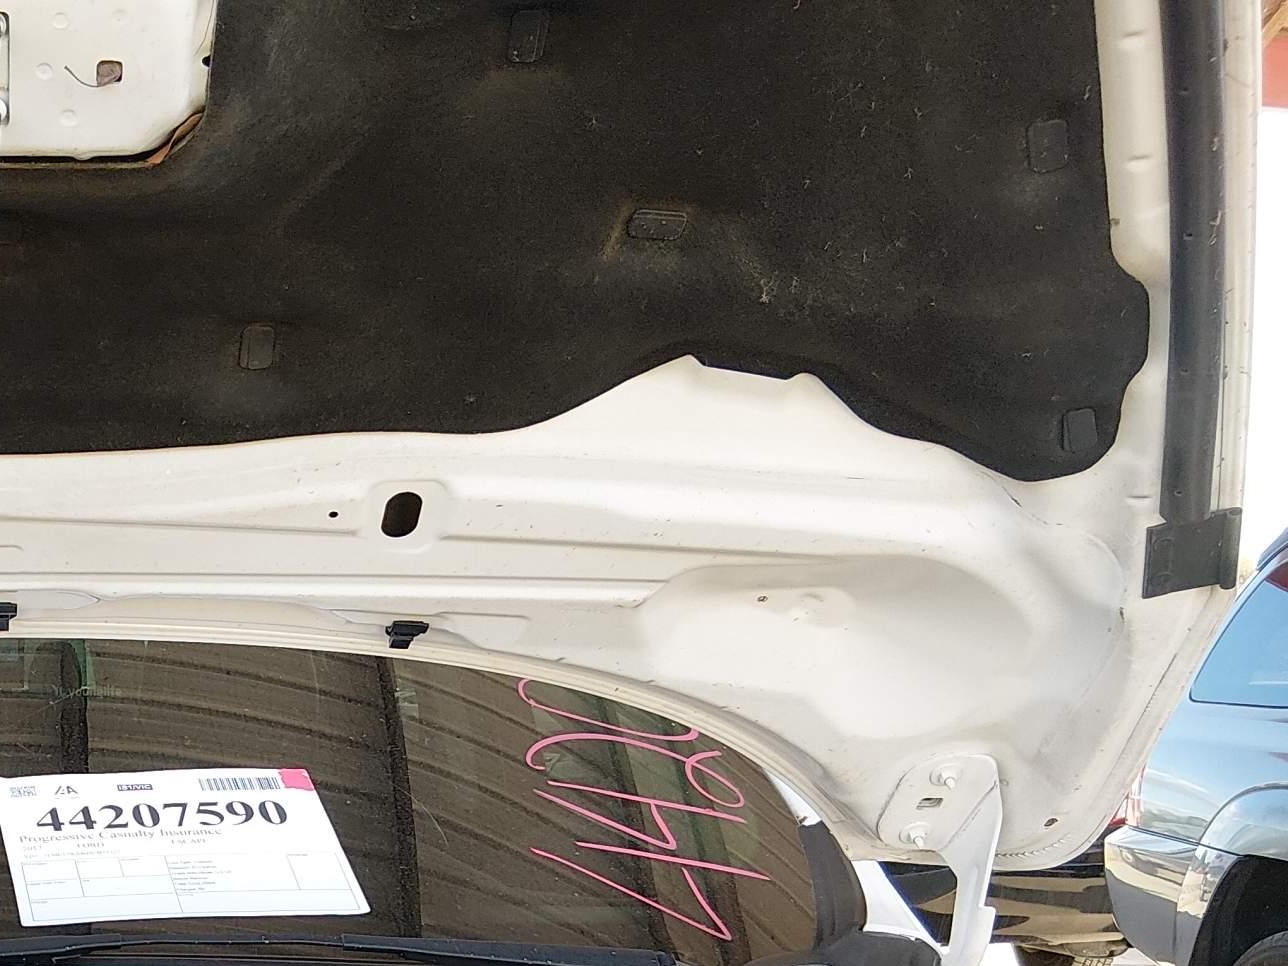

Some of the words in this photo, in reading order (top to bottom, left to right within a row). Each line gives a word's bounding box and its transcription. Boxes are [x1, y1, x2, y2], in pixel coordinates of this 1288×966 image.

[37, 799, 288, 832] 44207590
[19, 832, 95, 845] Progressive
[98, 829, 155, 842] Casualty
[159, 828, 223, 838] Insurance
